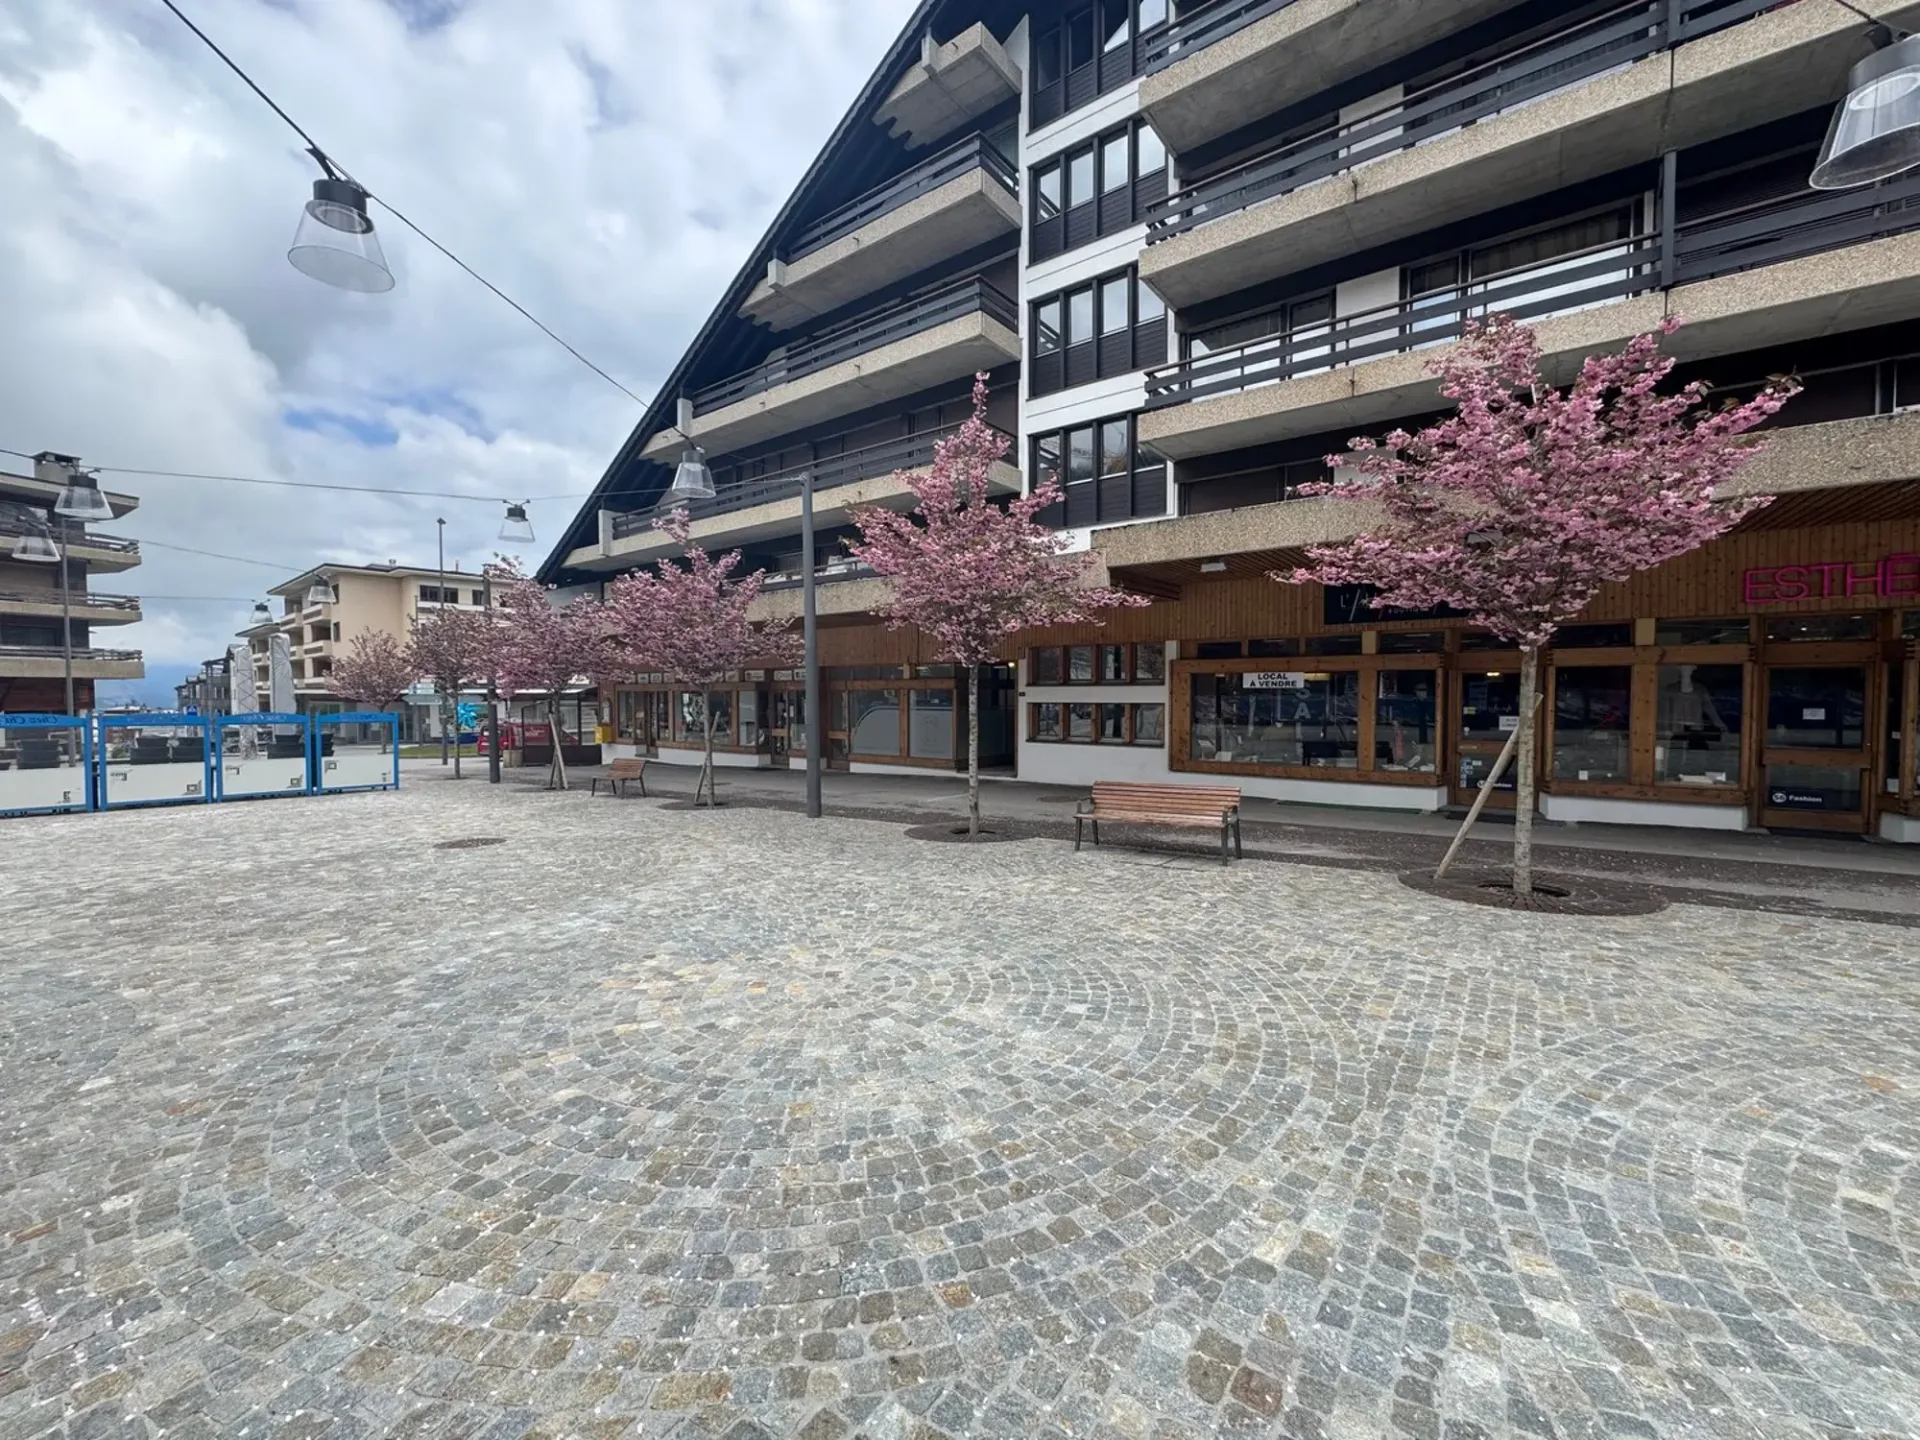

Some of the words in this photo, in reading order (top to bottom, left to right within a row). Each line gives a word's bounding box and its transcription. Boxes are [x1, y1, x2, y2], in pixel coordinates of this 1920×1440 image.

[1744, 554, 1920, 604] ESTHE
[1257, 672, 1289, 681] LOCAL
[1788, 794, 1823, 803] Fashion
